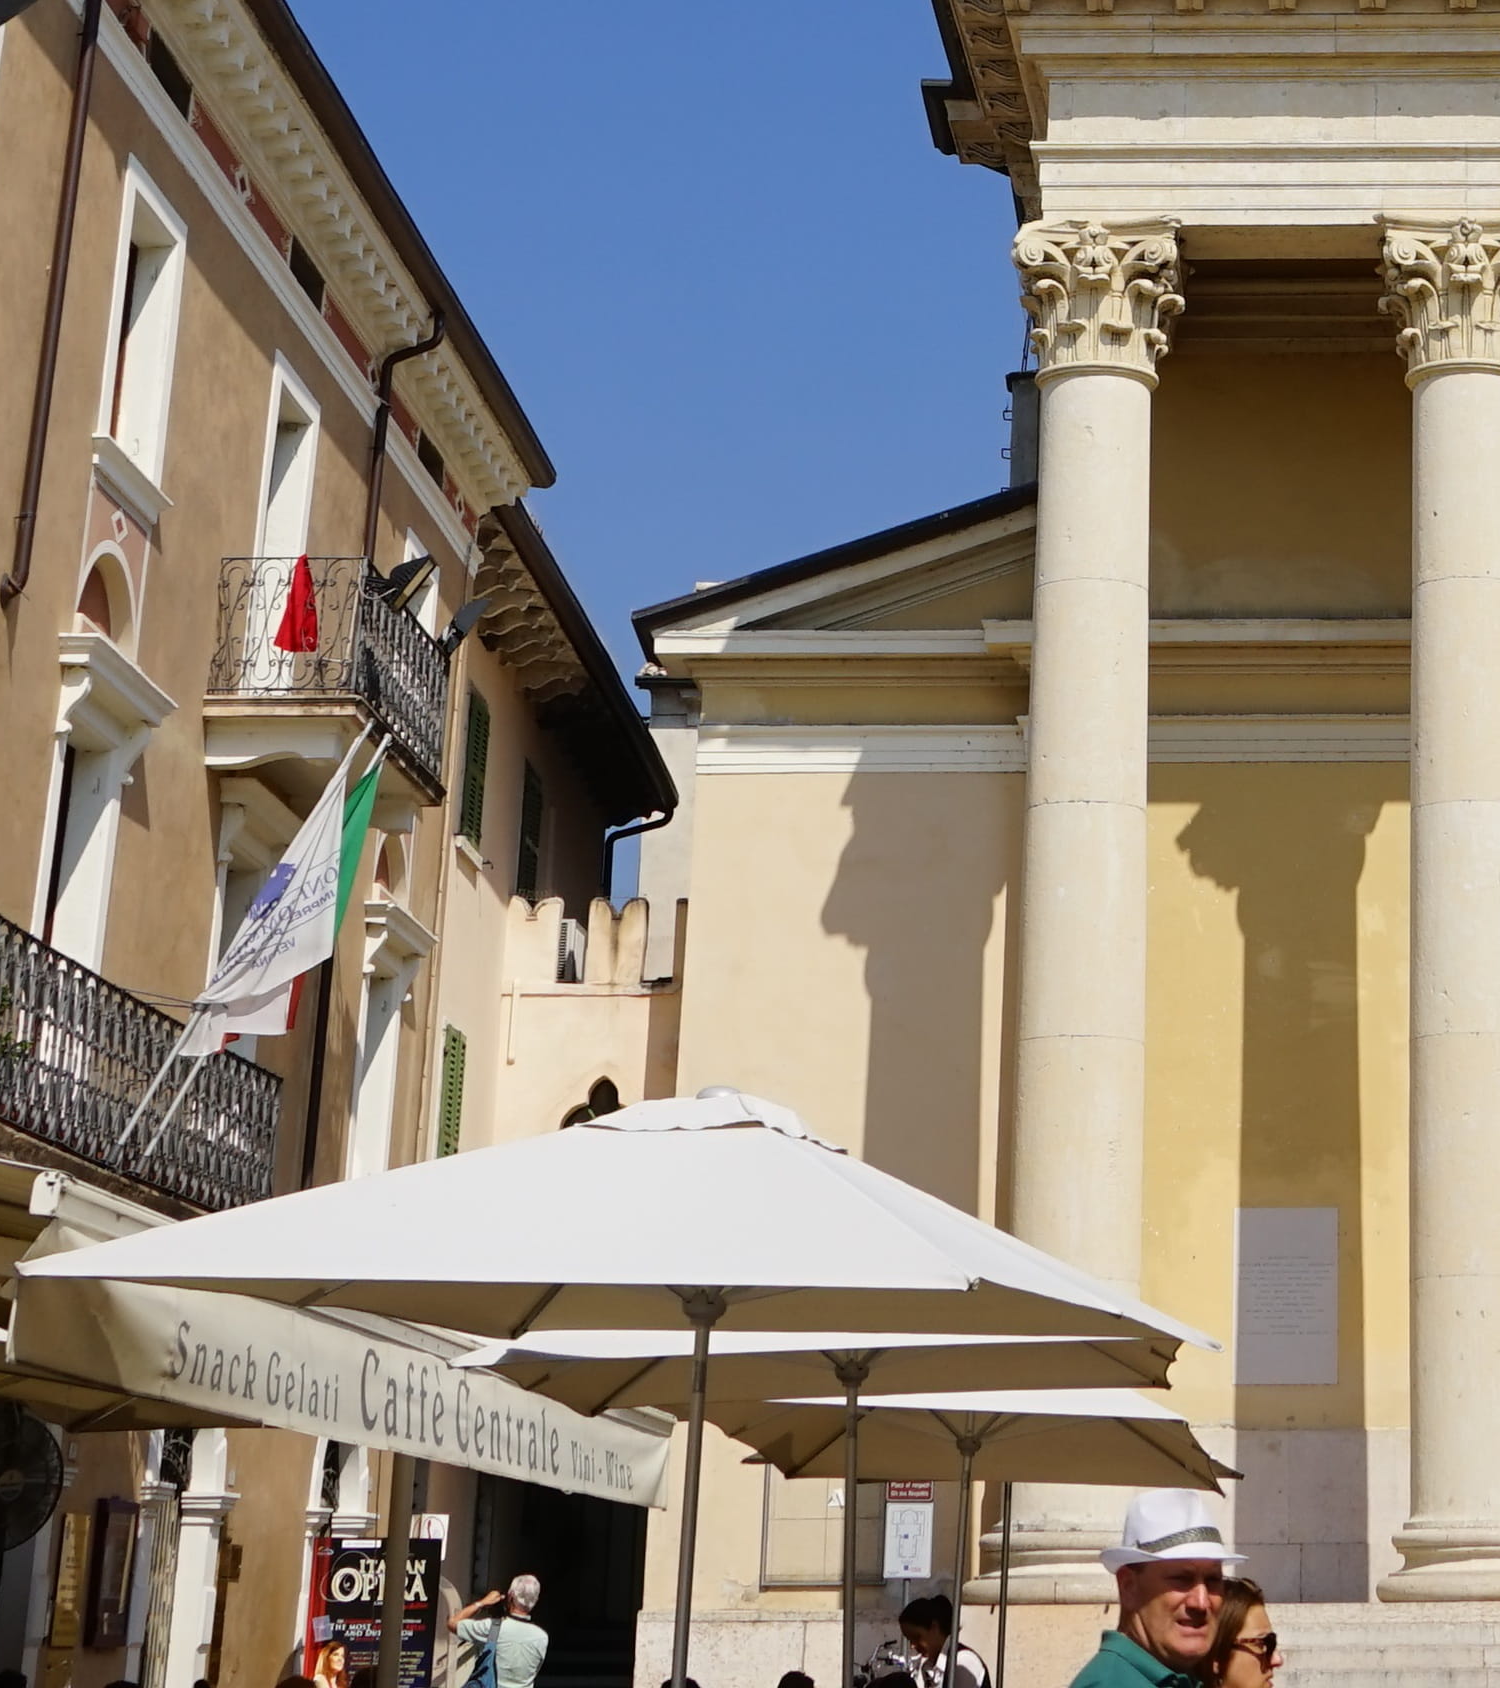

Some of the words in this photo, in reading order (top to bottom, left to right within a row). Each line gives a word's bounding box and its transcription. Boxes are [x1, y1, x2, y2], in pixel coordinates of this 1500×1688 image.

[171, 1319, 257, 1400] Snack
[265, 1350, 339, 1423] Gelati
[360, 1348, 445, 1447] Caffè
[456, 1378, 560, 1476] Centrale
[570, 1439, 596, 1484] Vini
[605, 1449, 634, 1491] Wine
[360, 1559, 426, 1574] ITAAN
